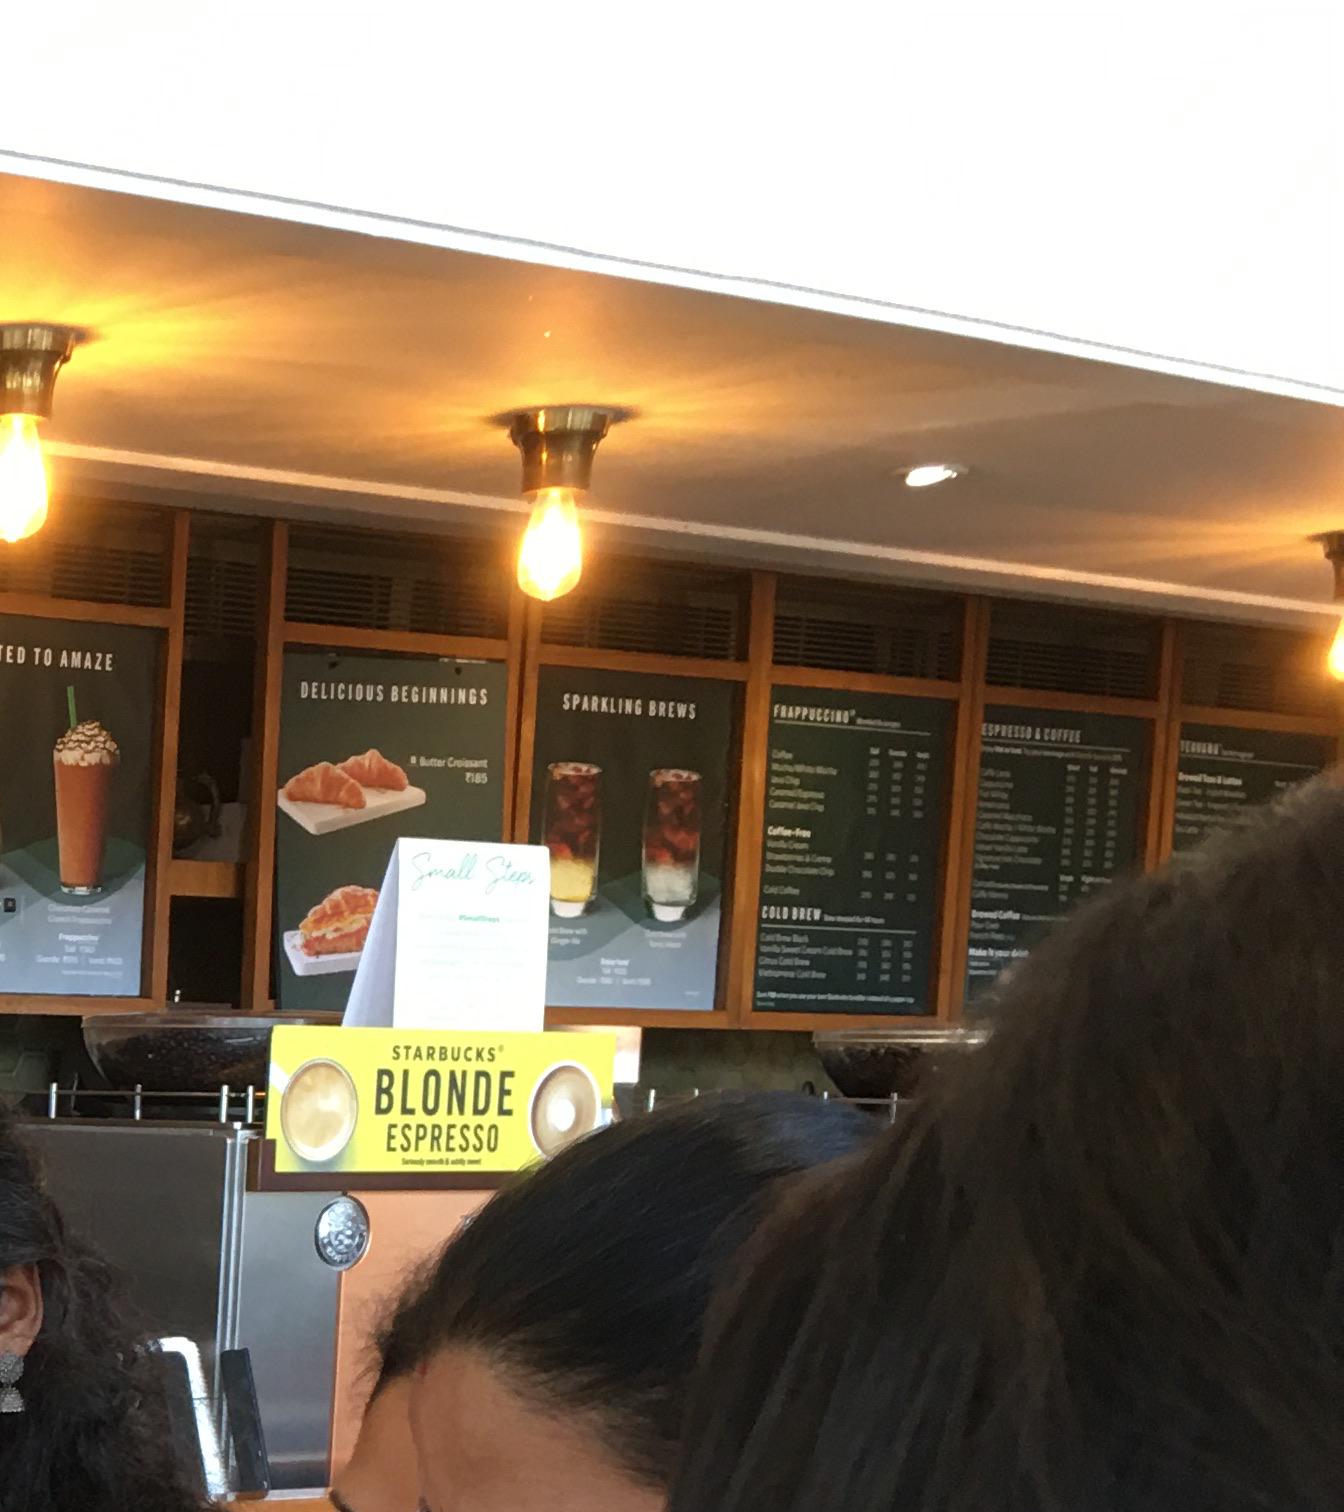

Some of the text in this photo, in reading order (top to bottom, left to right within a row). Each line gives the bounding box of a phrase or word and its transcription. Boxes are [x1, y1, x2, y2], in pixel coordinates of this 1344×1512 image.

[33, 647, 53, 666] TO
[59, 650, 113, 671] AMAZE
[300, 681, 488, 705] DELICIOUS BEGINNINGS
[562, 693, 697, 720] SPARKLING BREWS
[773, 704, 850, 723] FRAPPUCCINO
[981, 723, 1032, 740] ESPRESSO
[1043, 728, 1082, 743] COFFEE
[761, 905, 789, 919] COLD
[791, 907, 822, 921] BREW
[392, 1045, 496, 1062] STARBUCKS
[374, 1068, 516, 1116] BLONDE
[386, 1123, 500, 1153] ESPRESSO
